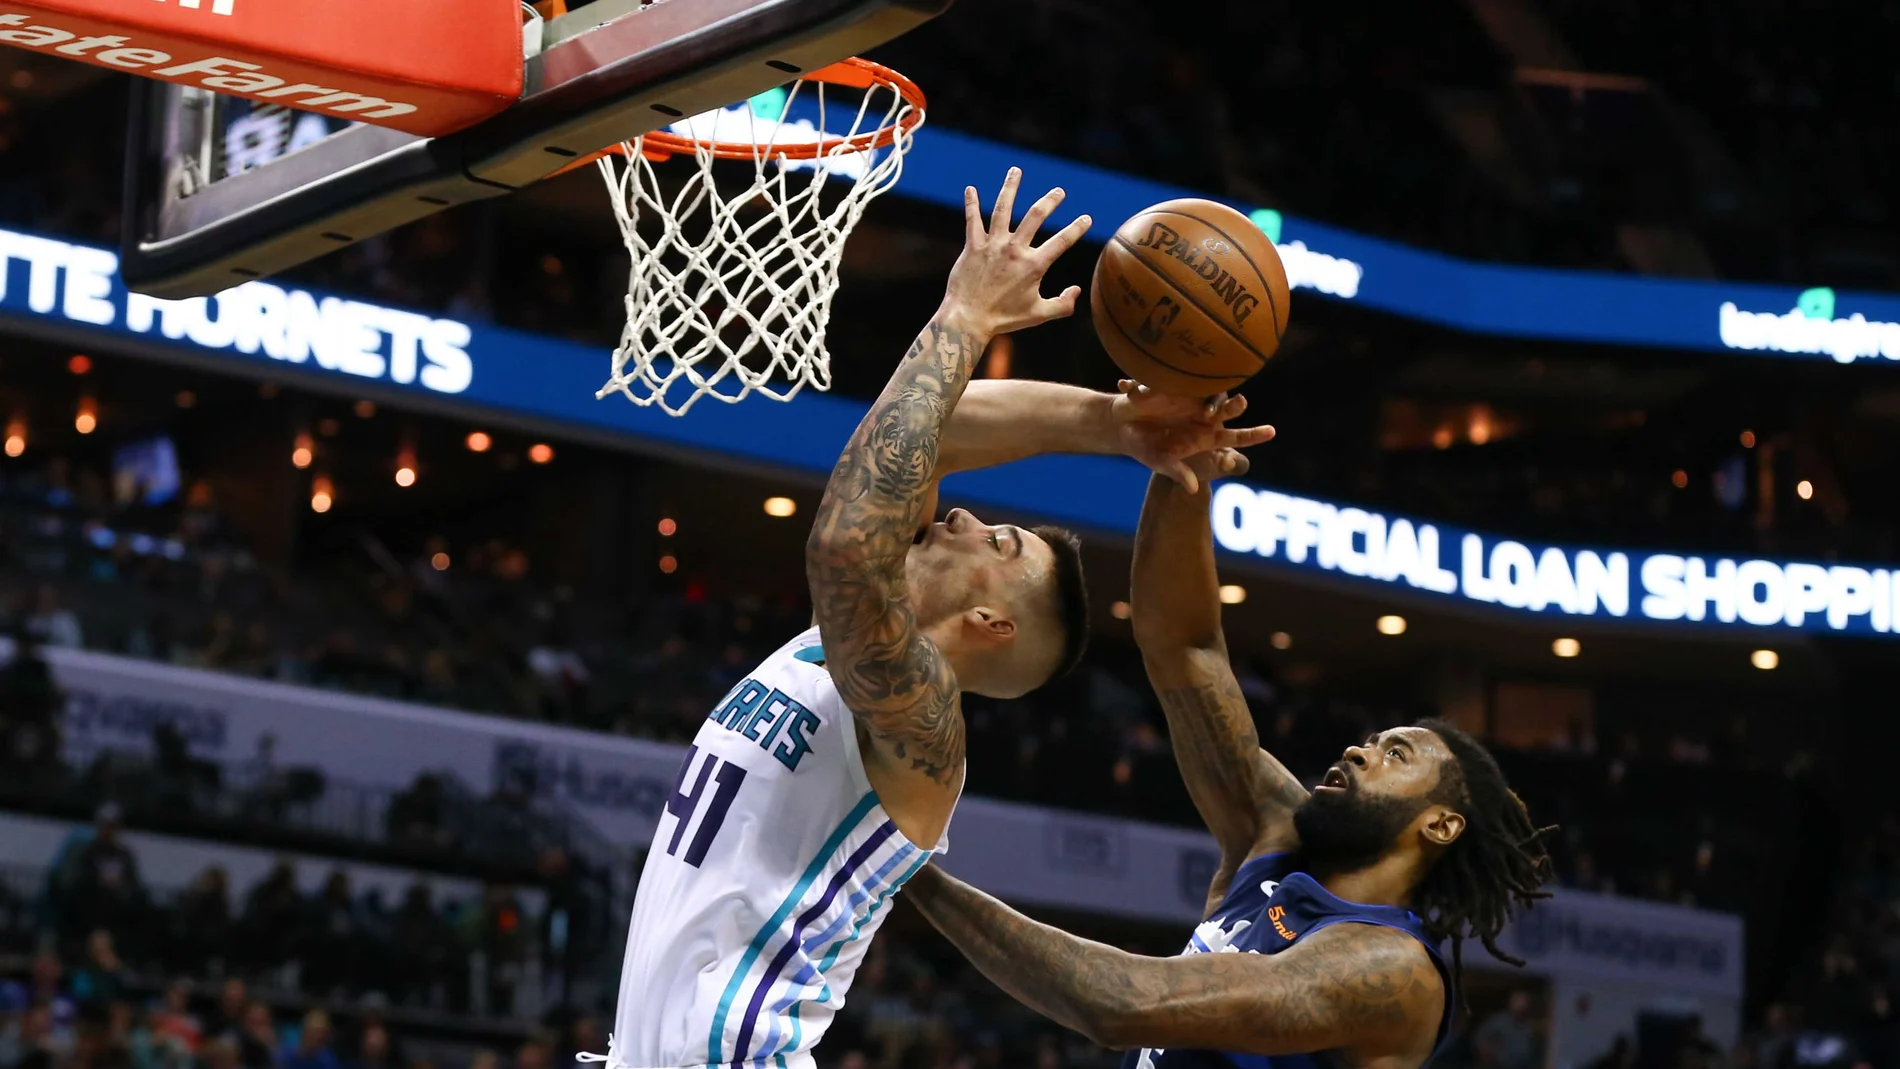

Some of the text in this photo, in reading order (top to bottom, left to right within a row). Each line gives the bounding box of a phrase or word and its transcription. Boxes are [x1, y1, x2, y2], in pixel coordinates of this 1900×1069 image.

[151, 57, 417, 119] Farm
[1137, 222, 1259, 327] SPALDING
[126, 280, 472, 393] HORNETS
[1211, 483, 1900, 634] OFFICIAL LOAN SHOPPI
[667, 744, 747, 868] 41
